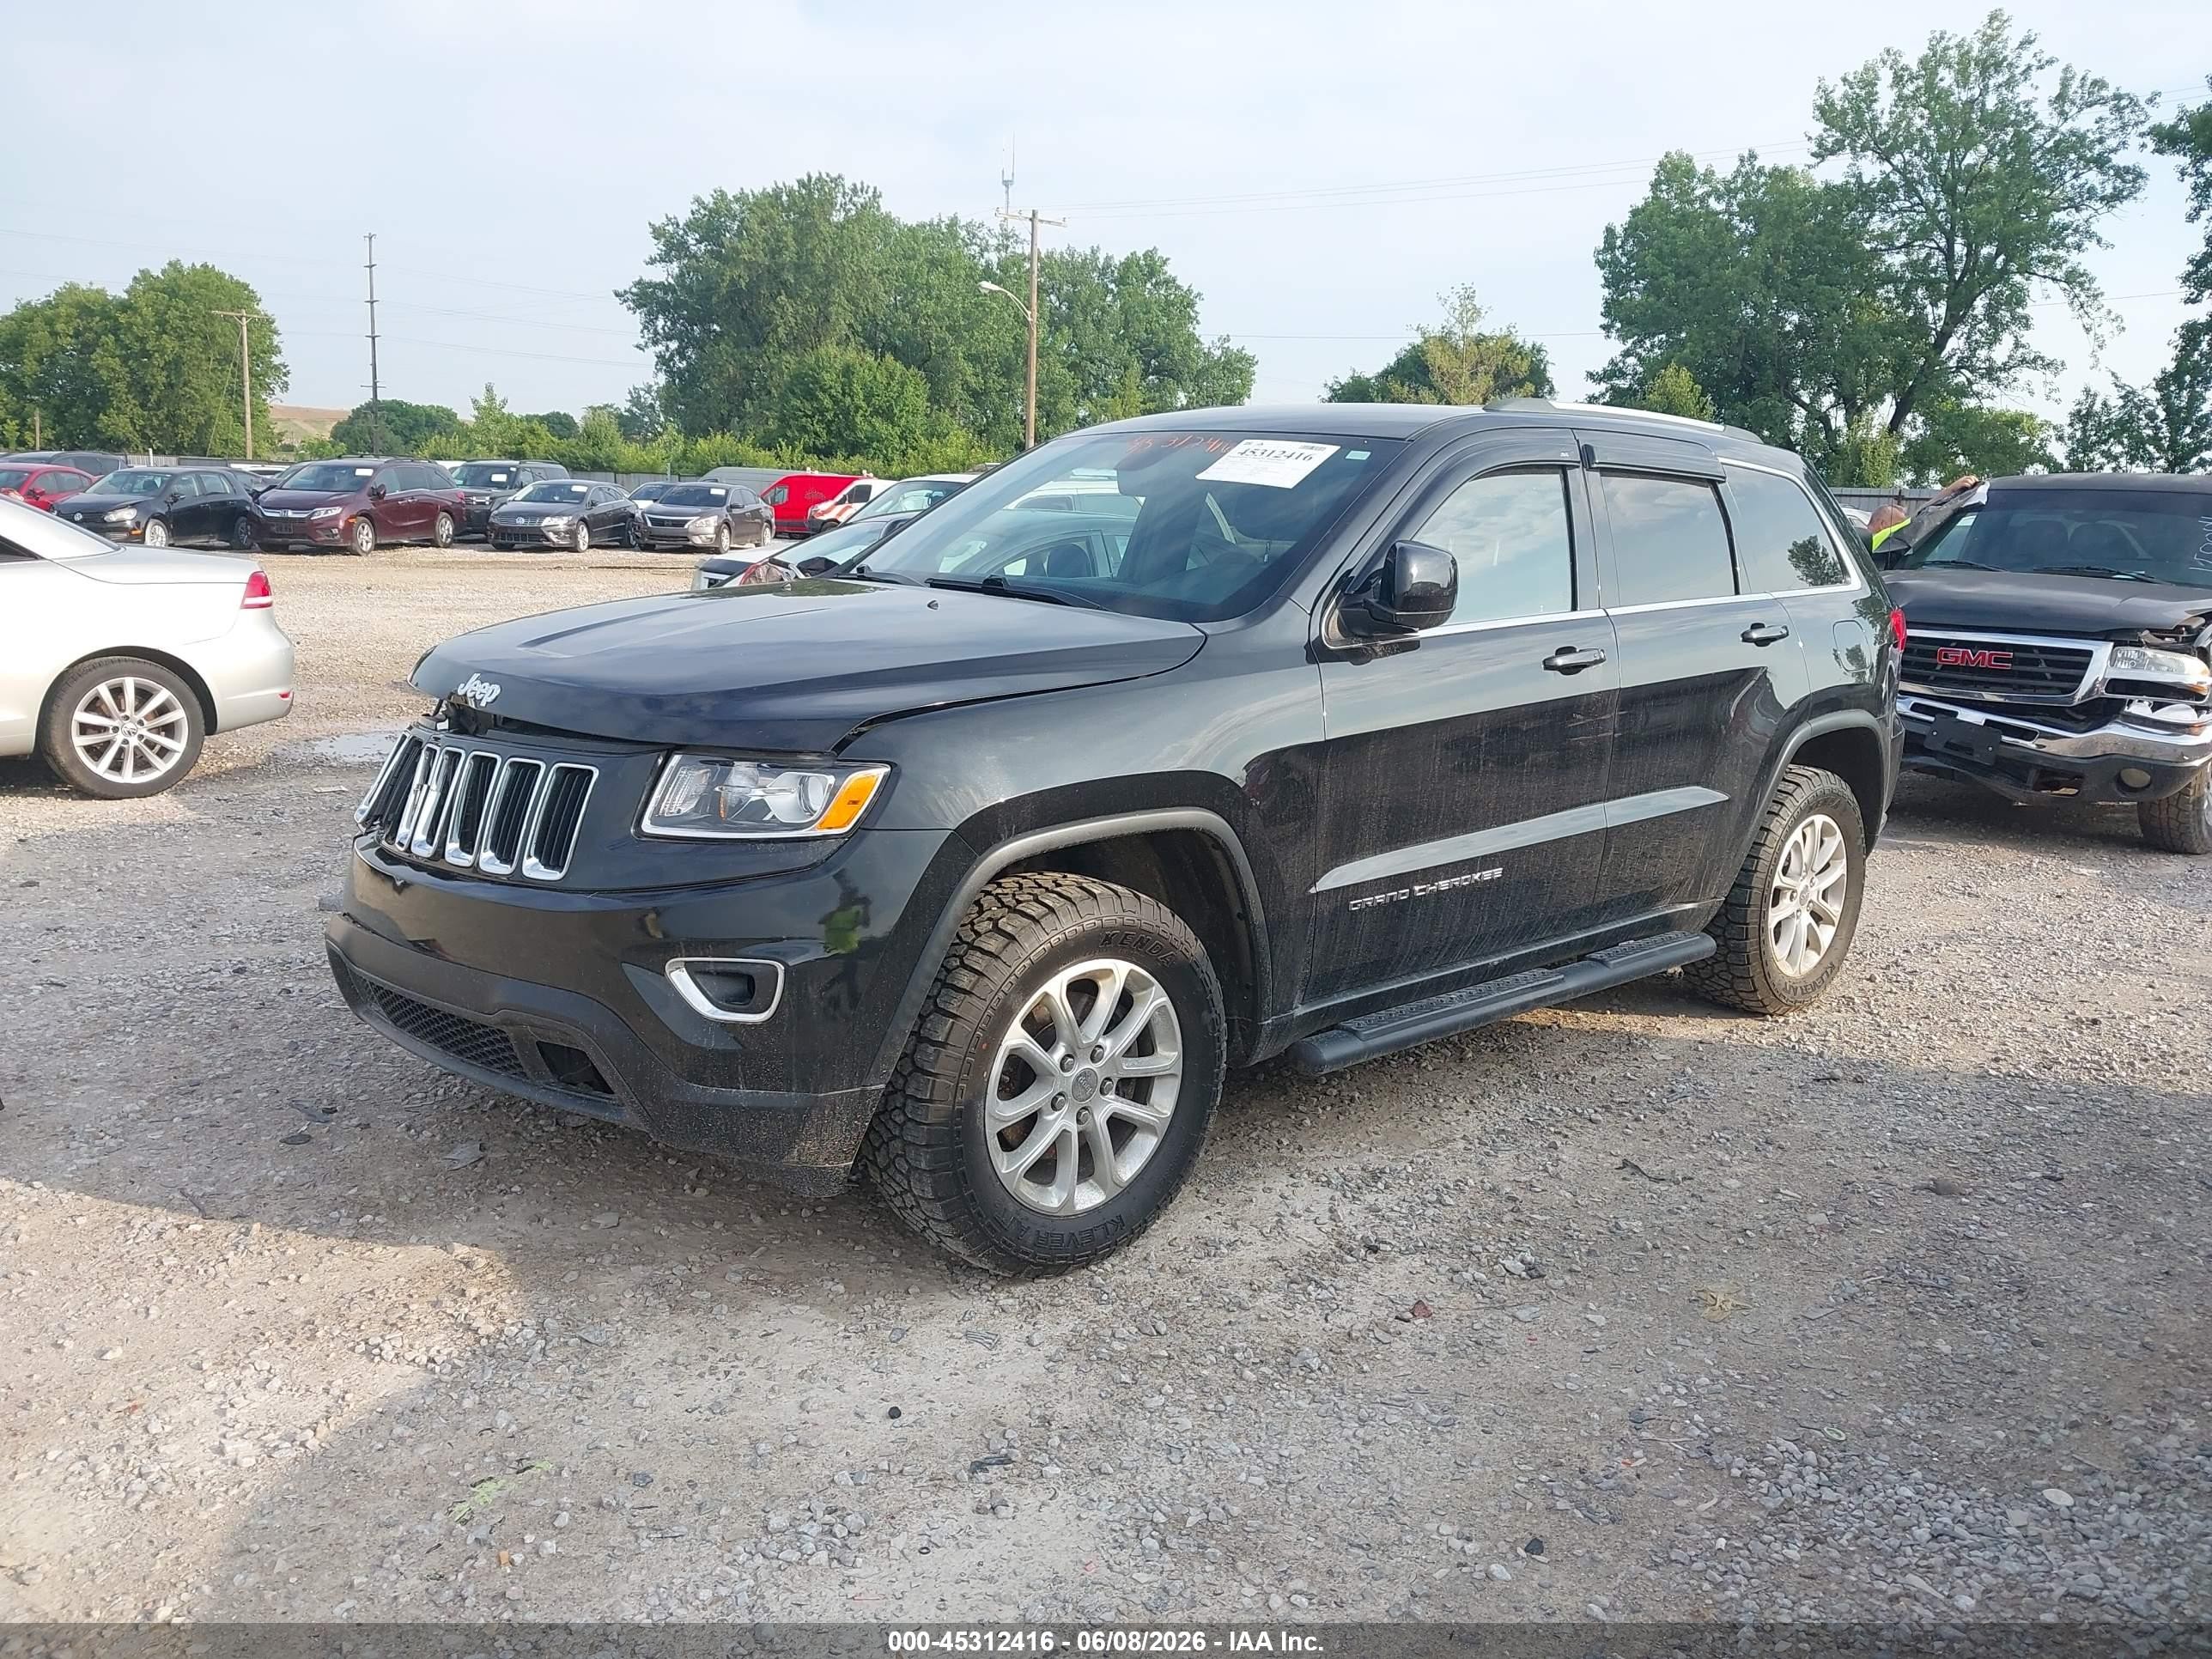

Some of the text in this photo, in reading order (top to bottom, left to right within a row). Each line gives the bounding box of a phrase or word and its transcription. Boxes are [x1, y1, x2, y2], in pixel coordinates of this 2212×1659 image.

[1237, 448, 1313, 461] 45312416
[1936, 647, 2014, 670] GMC
[457, 672, 501, 707] Jeep
[1348, 867, 1504, 911] GRAND CHEROKEE
[1098, 930, 1176, 967] KENDA
[1035, 1213, 1126, 1249] KLEVER
